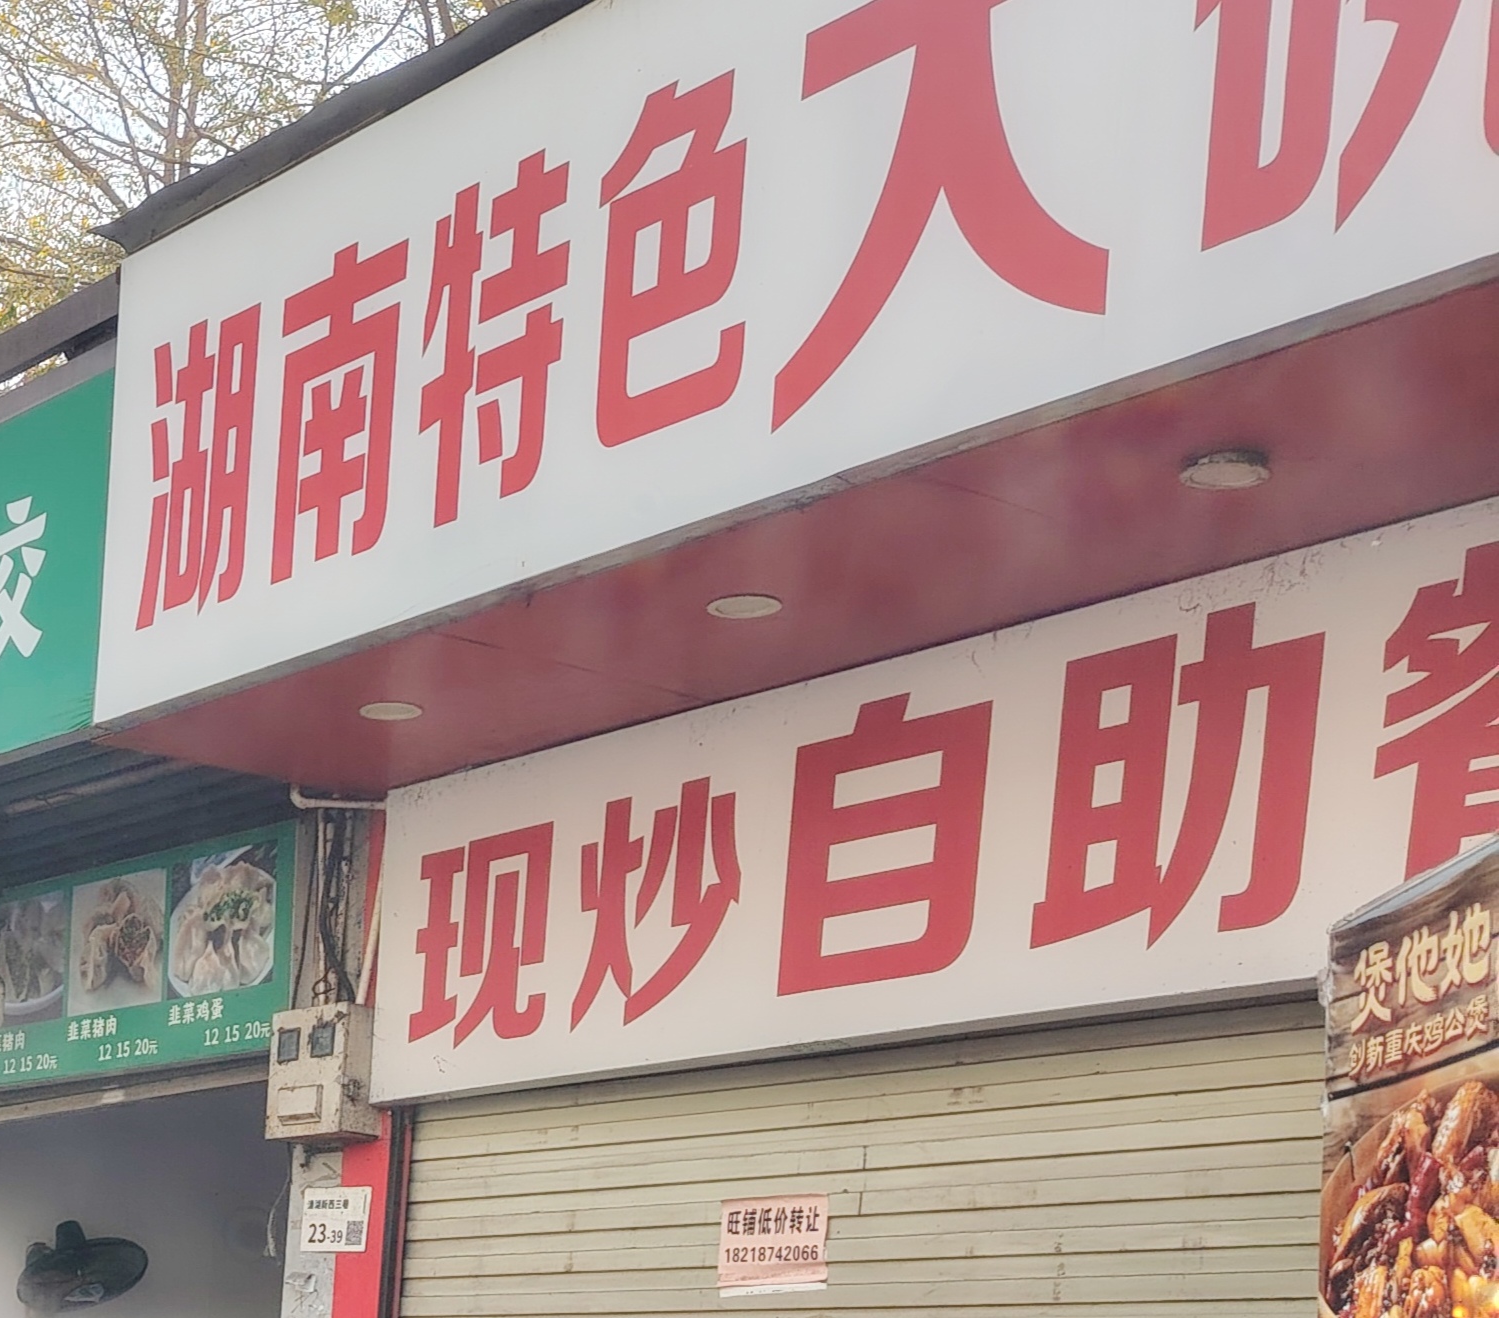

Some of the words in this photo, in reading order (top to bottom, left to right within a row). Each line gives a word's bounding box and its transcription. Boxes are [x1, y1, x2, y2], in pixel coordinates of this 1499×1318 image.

[1351, 902, 1492, 1034] 煲他她
[167, 998, 223, 1026] 韭菜鸡蛋
[67, 1015, 117, 1041] 韭菜猪肉
[204, 1029, 218, 1046] 12
[224, 1026, 239, 1043] 15
[245, 1022, 271, 1039] 20元
[1349, 994, 1490, 1077] 创新重庆鸡公煲
[99, 1044, 111, 1061] 12
[116, 1042, 130, 1058] 15
[135, 1038, 158, 1055] 20元
[3, 1059, 16, 1074] 12
[20, 1057, 32, 1072] 15
[37, 1053, 58, 1070] 20元
[726, 1205, 821, 1236] 旺铺低价转让
[307, 1223, 343, 1244] 23-39
[724, 1244, 819, 1264] 18218742066
